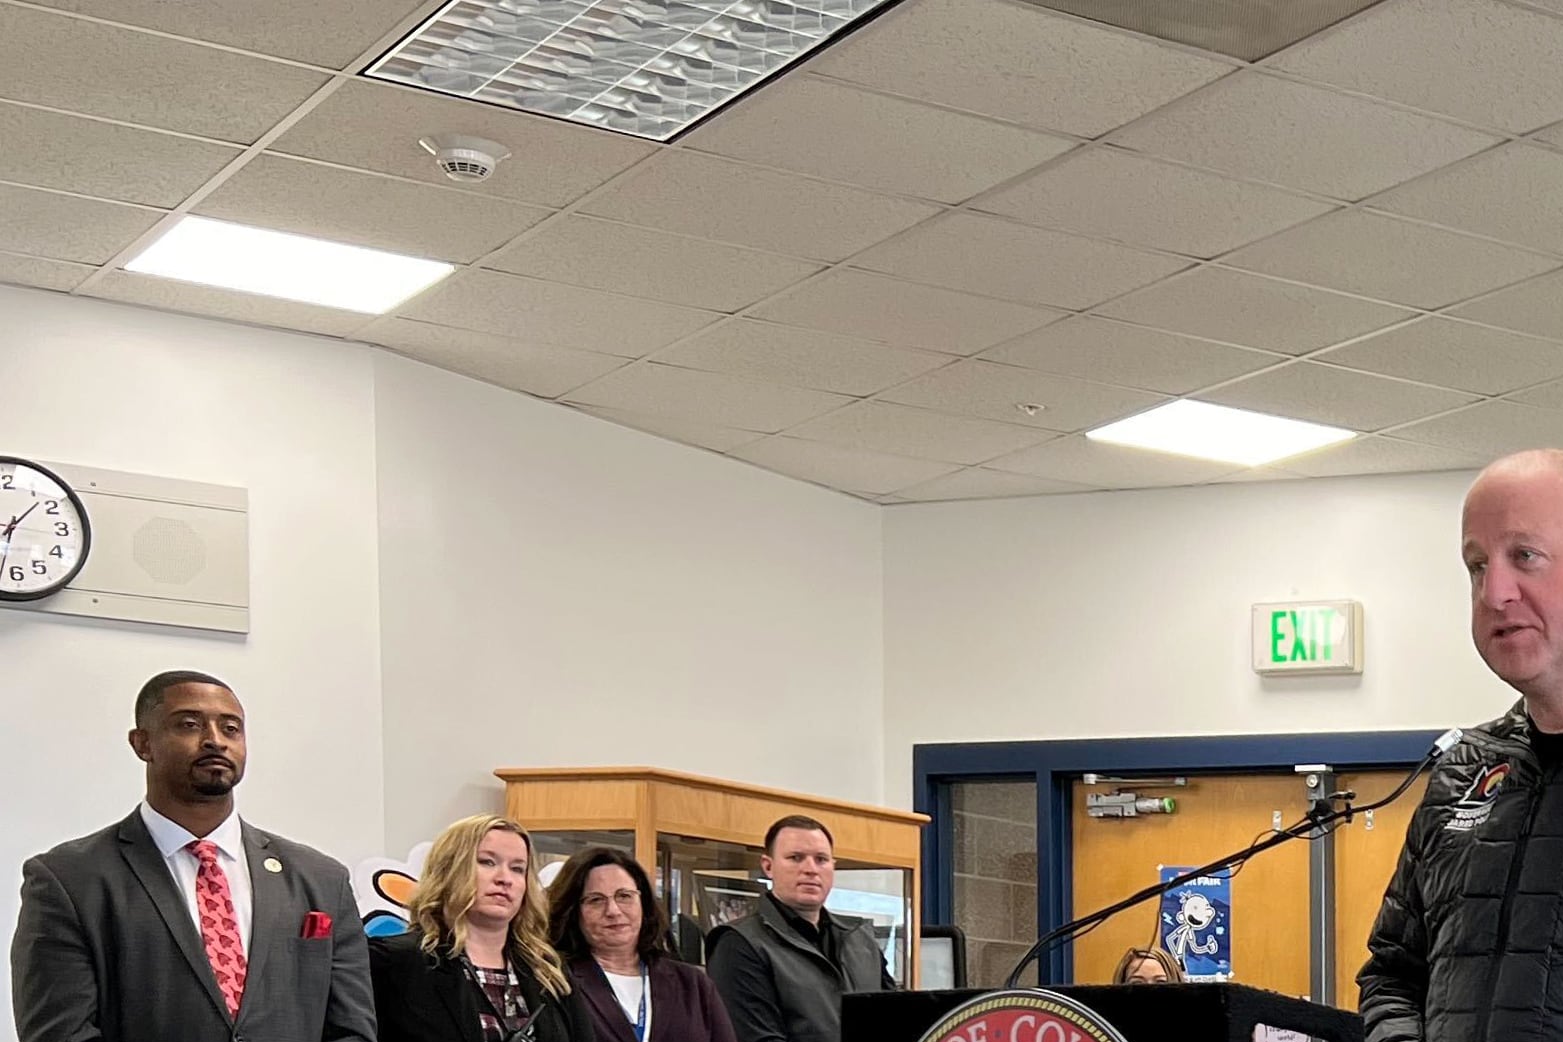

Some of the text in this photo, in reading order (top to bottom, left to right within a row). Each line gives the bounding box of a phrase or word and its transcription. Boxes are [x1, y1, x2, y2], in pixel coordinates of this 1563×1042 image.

[44, 500, 60, 515] 2
[54, 521, 70, 537] 3
[49, 544, 64, 559] 4
[9, 566, 25, 581] 6
[32, 559, 48, 575] 5
[1271, 609, 1335, 662] EXIT
